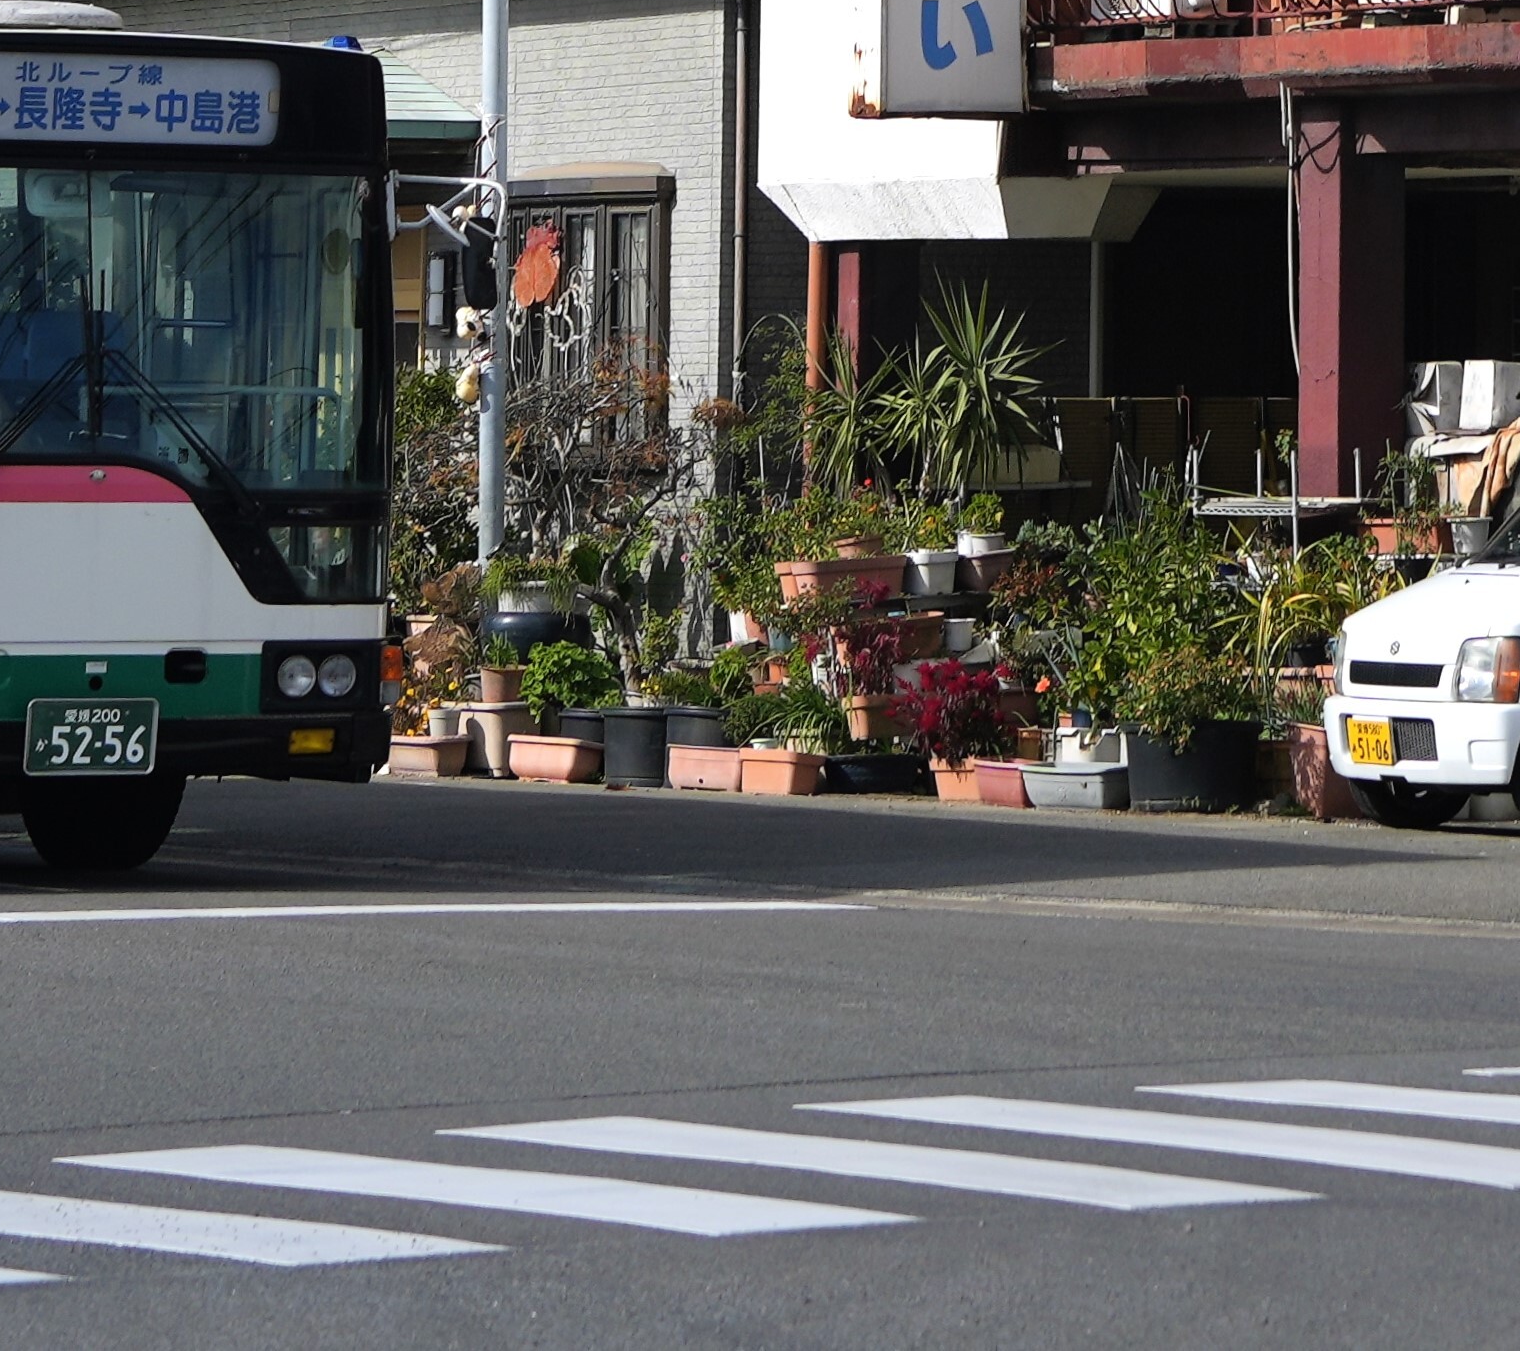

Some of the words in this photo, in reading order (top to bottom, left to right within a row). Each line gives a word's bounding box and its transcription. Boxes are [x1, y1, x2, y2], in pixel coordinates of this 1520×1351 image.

[15, 60, 163, 86] 北ループ線
[13, 86, 123, 131] 長隆寺
[154, 88, 261, 135] 中島港
[50, 725, 147, 764] 52-56
